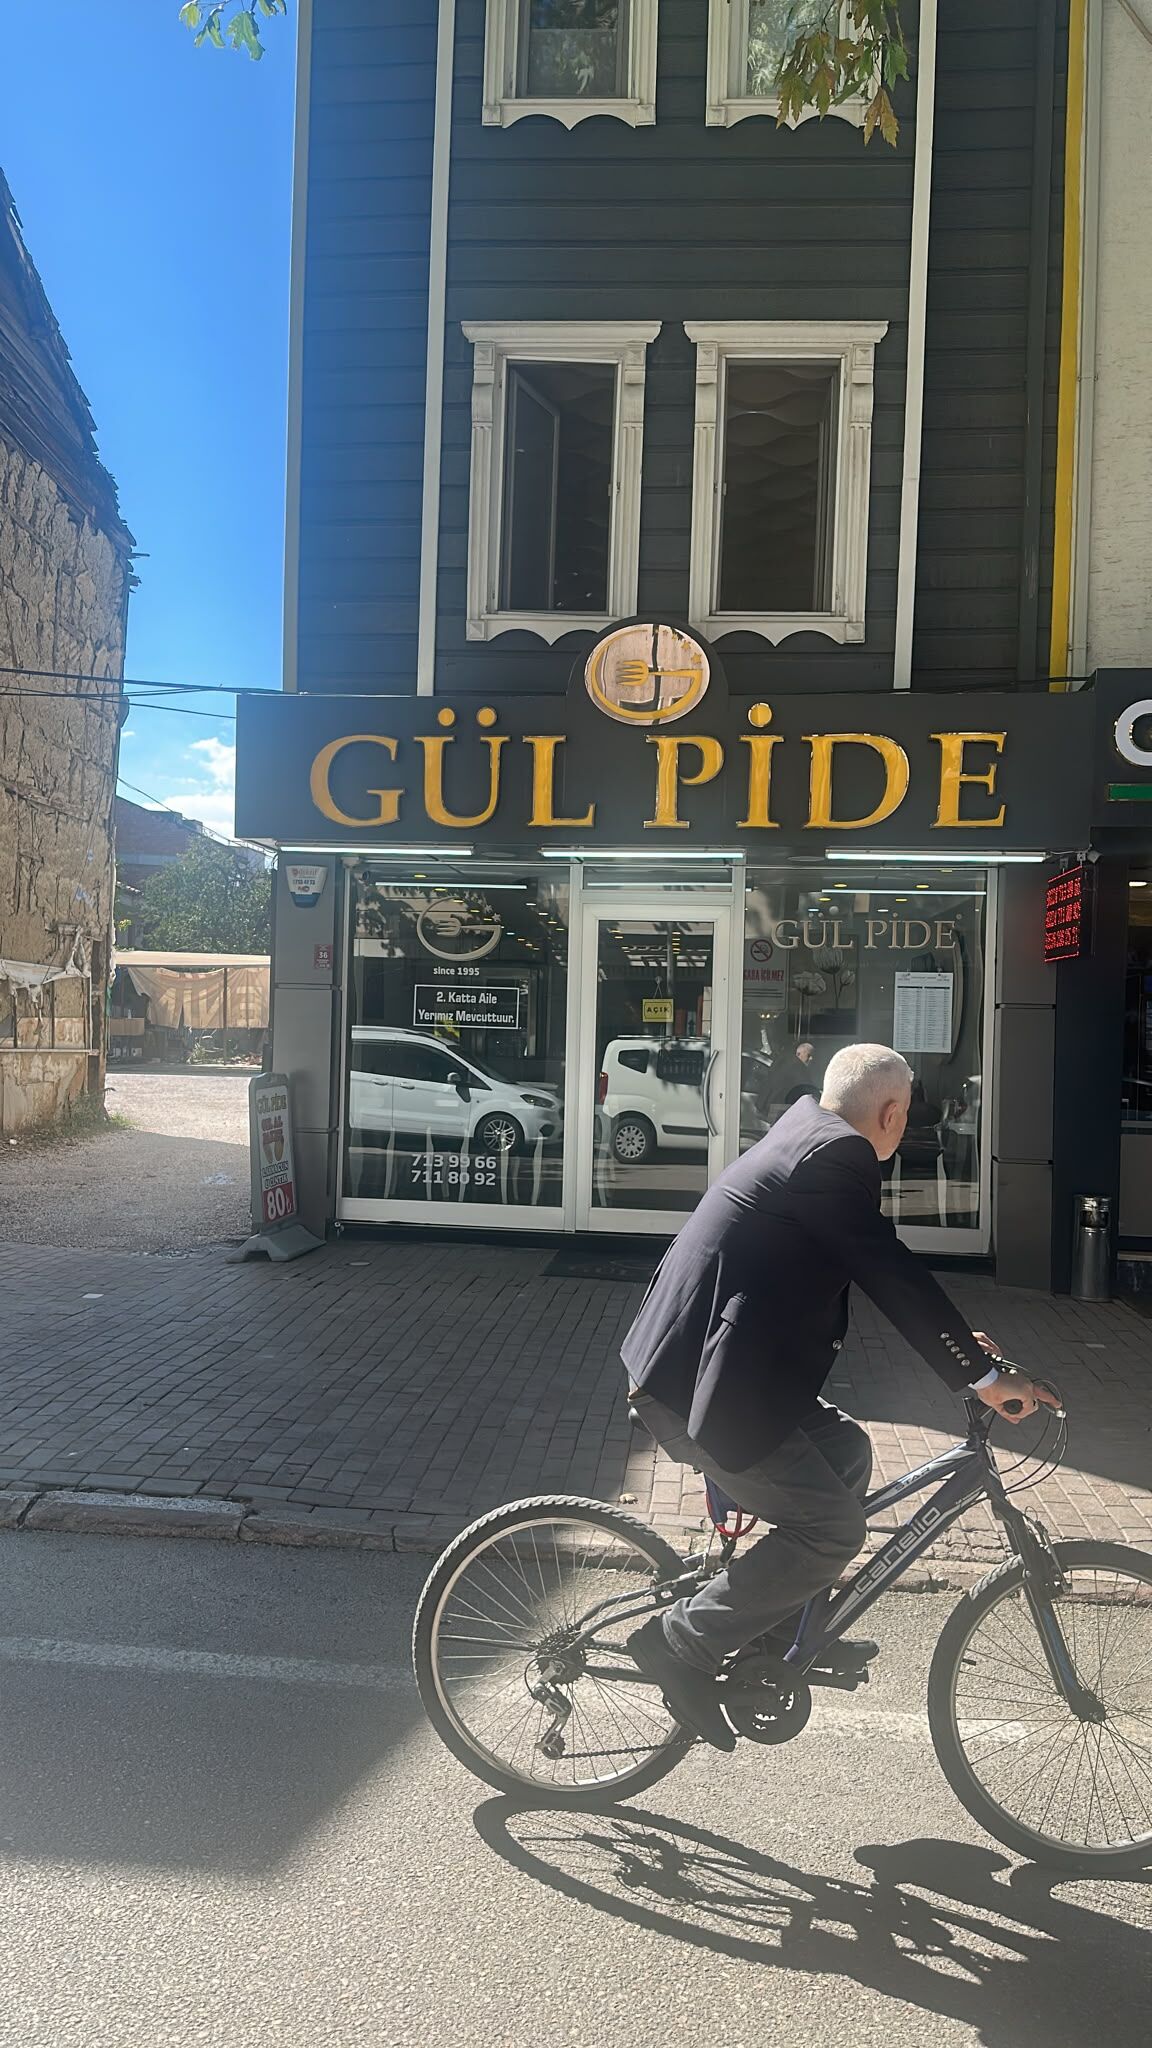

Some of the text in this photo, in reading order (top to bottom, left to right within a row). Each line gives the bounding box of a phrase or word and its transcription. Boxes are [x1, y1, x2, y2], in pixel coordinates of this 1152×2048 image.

[310, 707, 596, 827] GÜL
[643, 702, 1007, 830] PİDE
[771, 912, 957, 949] GÜL PİDE
[433, 966, 480, 976] since 1995
[436, 991, 498, 1004] 2. Katta Aile
[455, 1010, 515, 1023] Mevcuttuur.
[411, 1154, 497, 1169] 713 99 66
[411, 1170, 496, 1186] 711 80 92
[854, 1506, 941, 1595] canello
